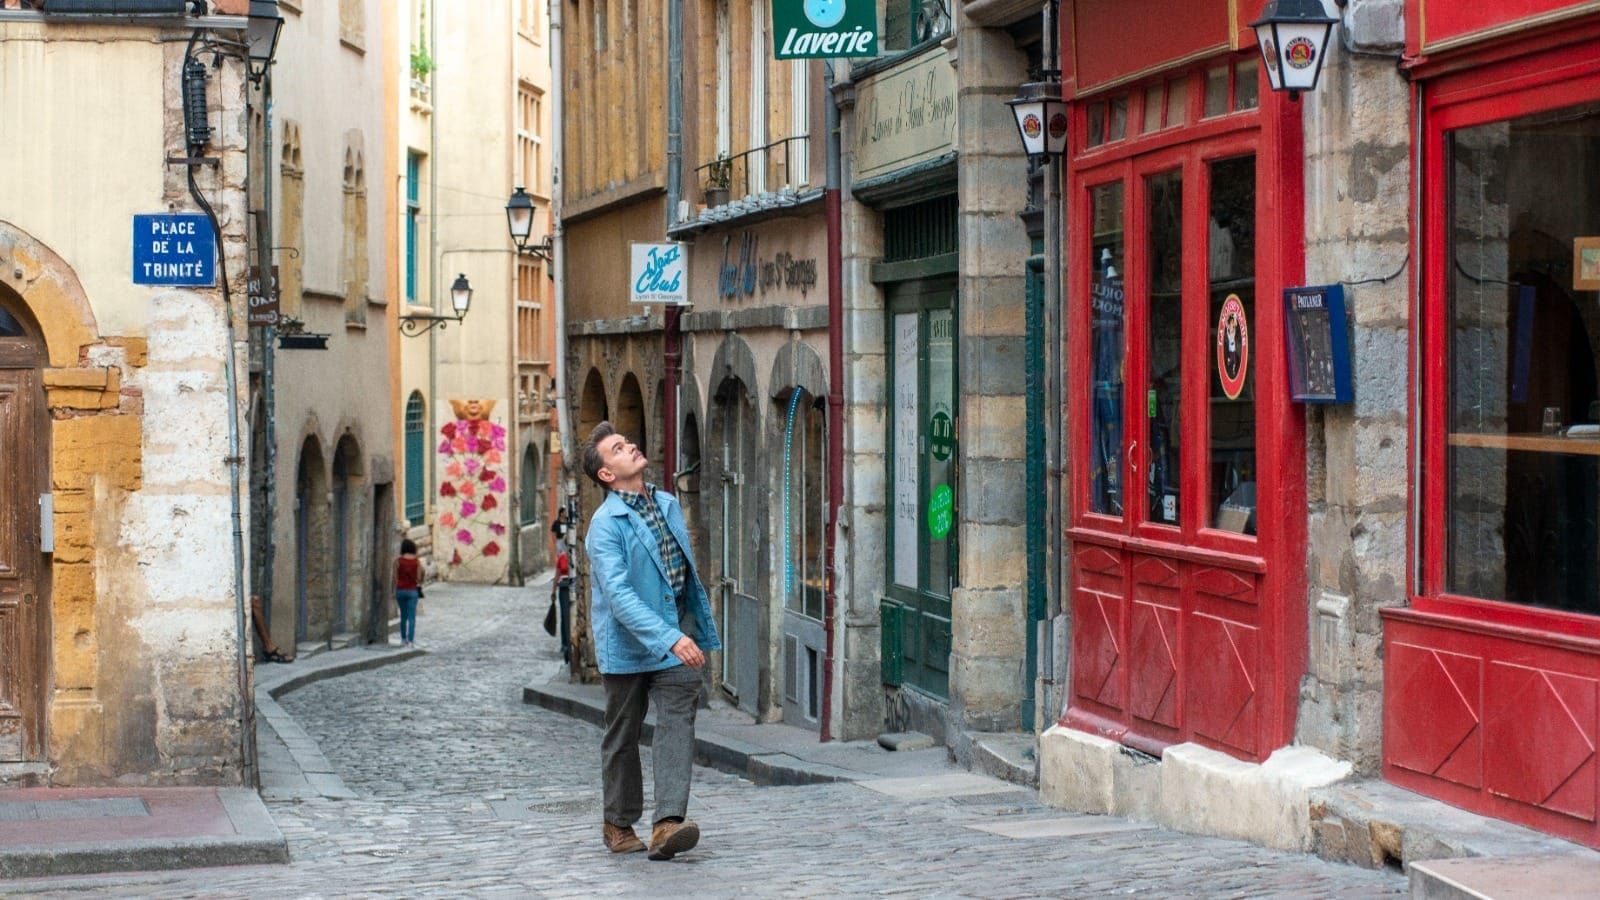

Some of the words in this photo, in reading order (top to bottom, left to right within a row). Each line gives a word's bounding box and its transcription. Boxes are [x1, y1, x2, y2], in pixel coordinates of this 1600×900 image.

[780, 25, 874, 55] Laverie
[152, 222, 195, 235] PLACE
[152, 241, 169, 253] DE
[177, 241, 194, 253] LA
[143, 260, 203, 277] TRINITÉ
[647, 246, 680, 280] Jazz
[636, 262, 681, 293] Club
[784, 251, 817, 299] Georges
[1297, 293, 1322, 308] PAULANER
